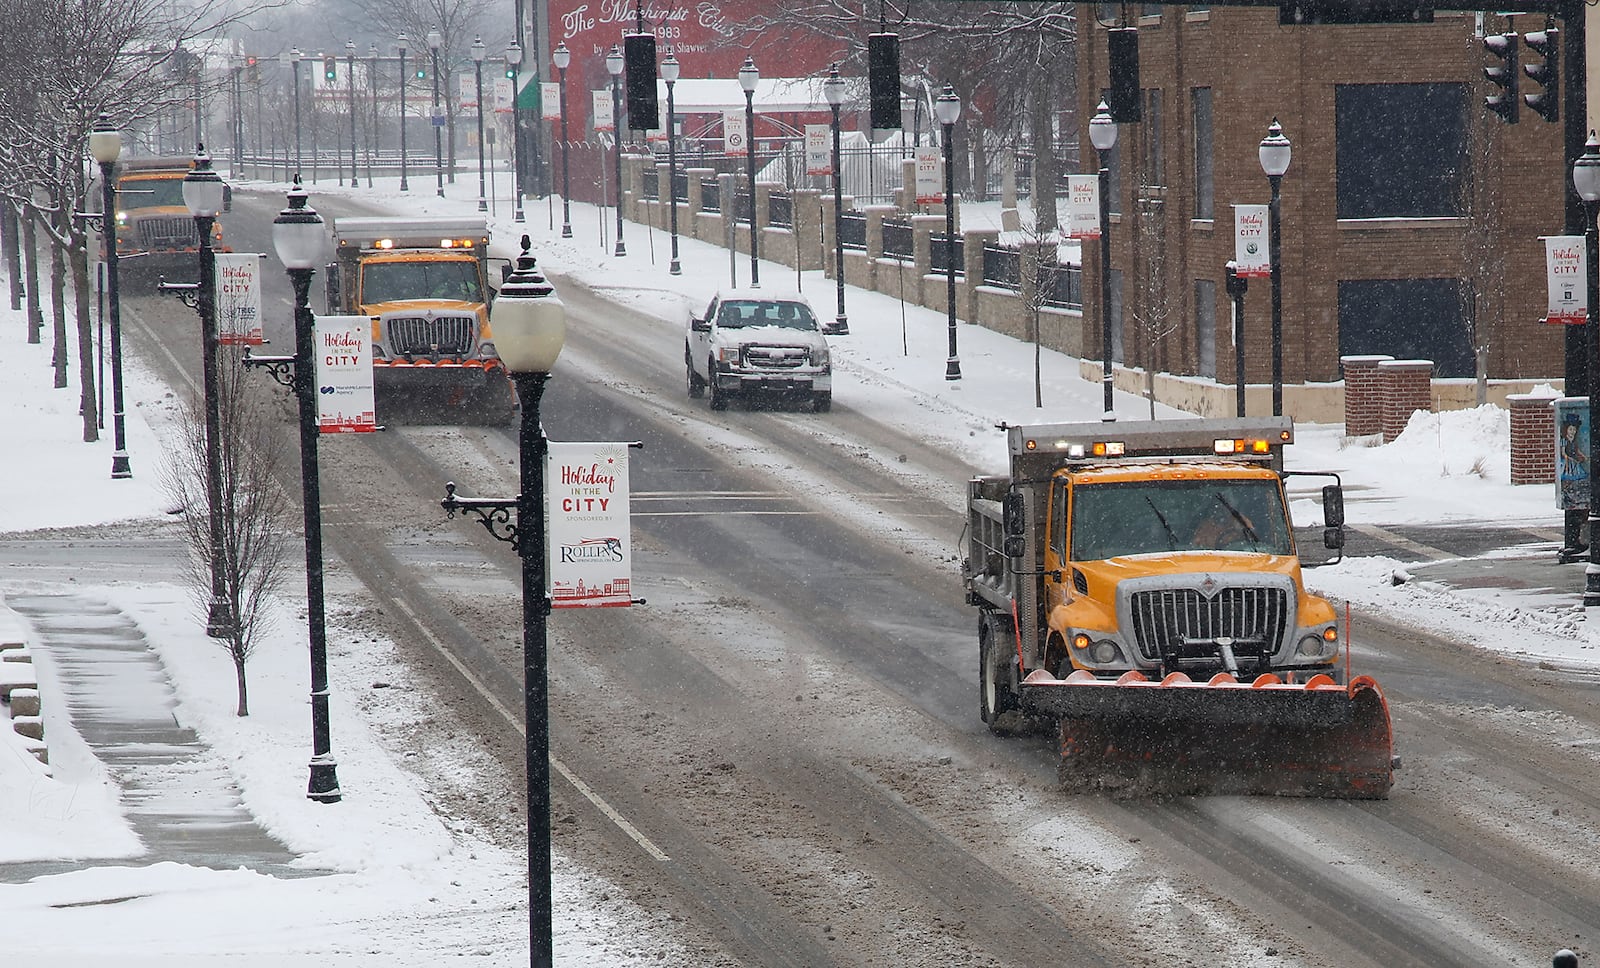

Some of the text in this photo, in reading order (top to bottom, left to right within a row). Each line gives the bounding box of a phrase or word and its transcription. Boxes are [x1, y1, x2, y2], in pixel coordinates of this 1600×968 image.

[561, 5, 595, 38] The
[653, 27, 680, 38] 1983
[593, 44, 603, 56] by
[1240, 214, 1263, 228] Holiday
[1553, 248, 1580, 263] Holiday
[222, 266, 252, 282] Holiday
[325, 332, 362, 352] Holiday
[326, 356, 358, 366] CITY
[561, 464, 615, 493] Holiday
[563, 499, 609, 512] CITY
